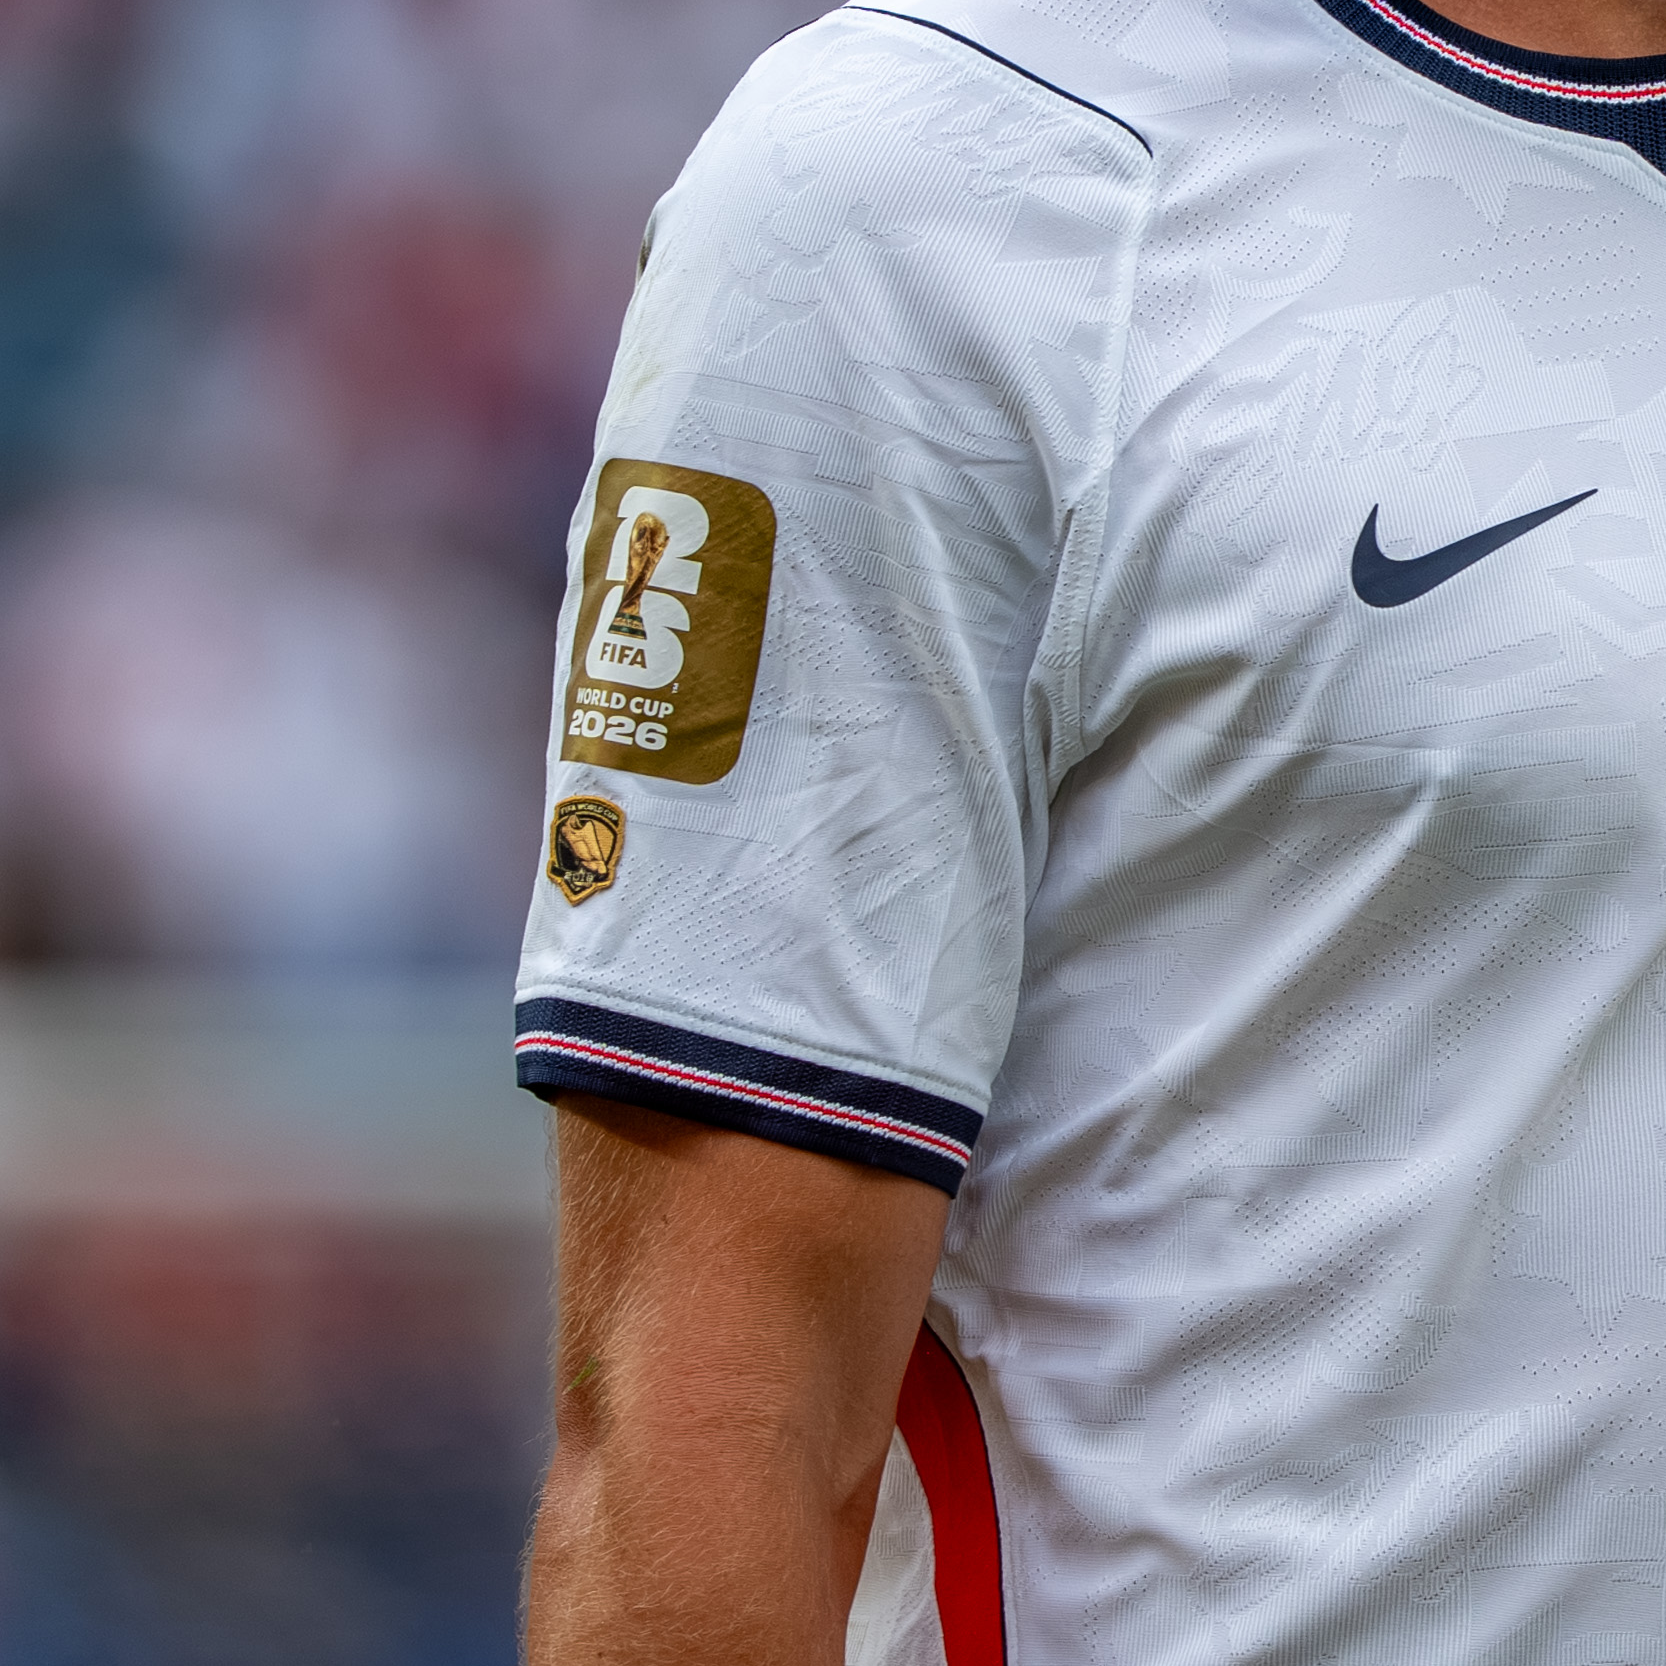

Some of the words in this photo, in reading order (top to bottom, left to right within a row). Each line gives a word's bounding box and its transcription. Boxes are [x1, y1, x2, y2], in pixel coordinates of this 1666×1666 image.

[599, 642, 648, 669] FIFA
[575, 687, 627, 710] WORLD
[629, 696, 675, 719] CUP
[568, 708, 668, 751] 2026
